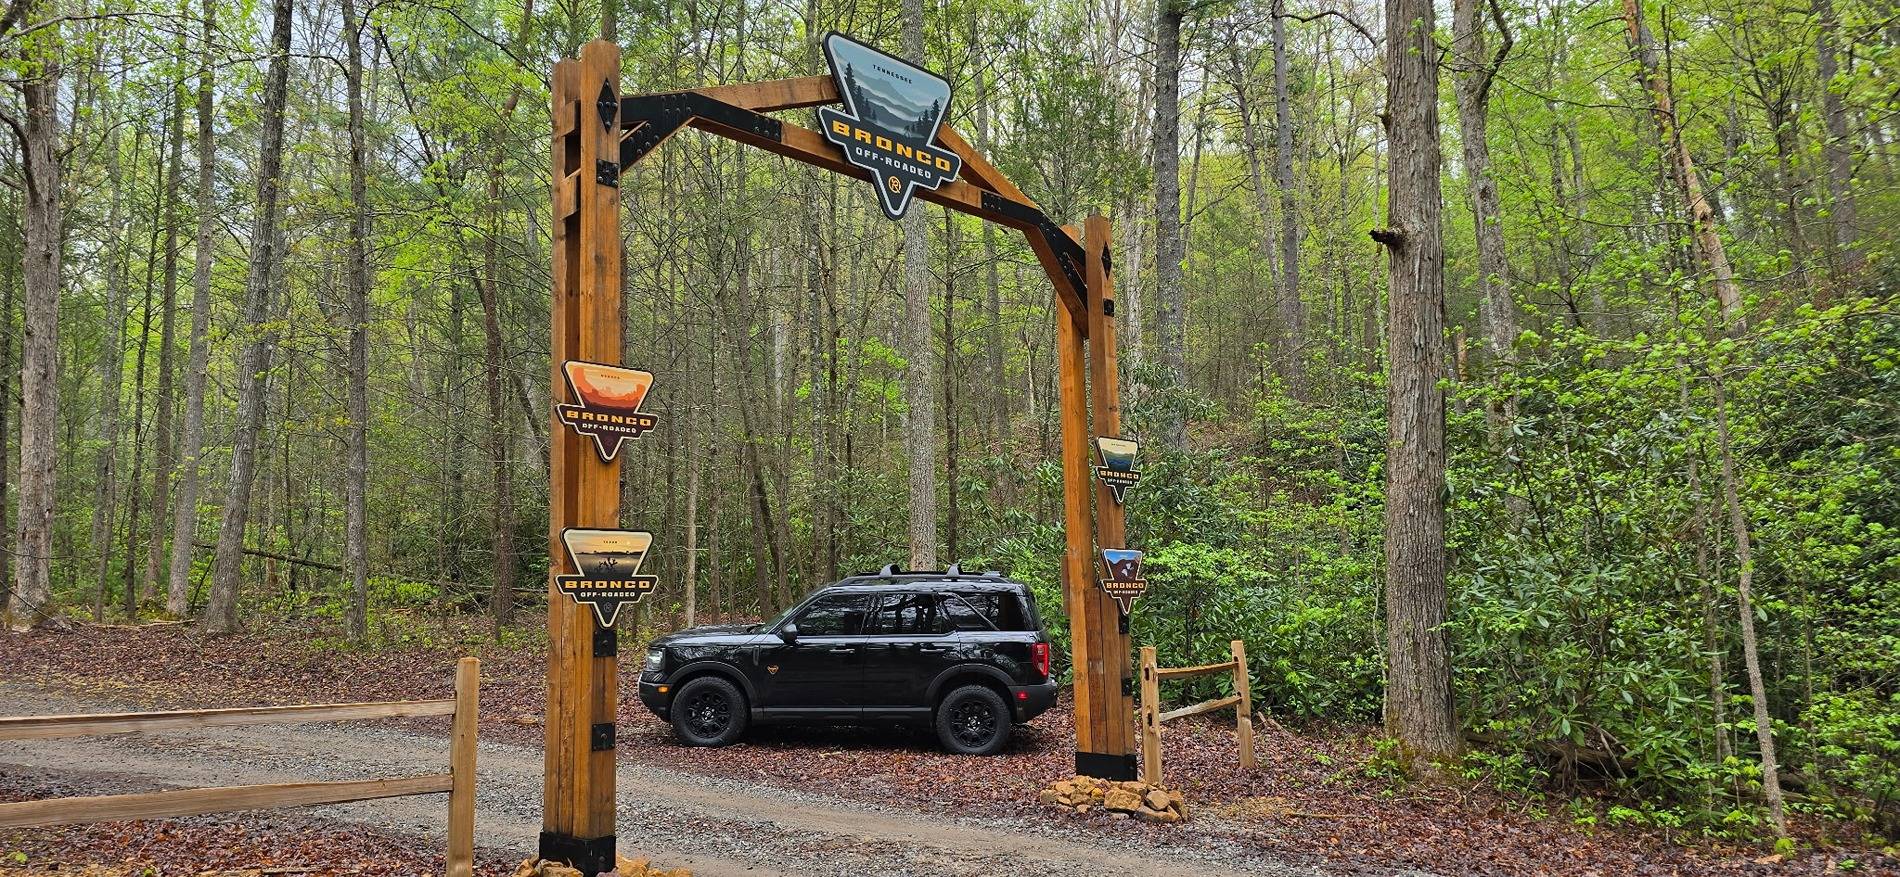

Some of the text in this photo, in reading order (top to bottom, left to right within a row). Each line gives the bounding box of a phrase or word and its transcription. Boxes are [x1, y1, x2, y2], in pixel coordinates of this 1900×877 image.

[872, 63, 913, 85] TENNESSEE
[832, 120, 951, 172] BRONCO
[566, 410, 651, 426] BRONCO
[1100, 470, 1139, 480] BRONCO
[565, 580, 650, 589] BRONCO
